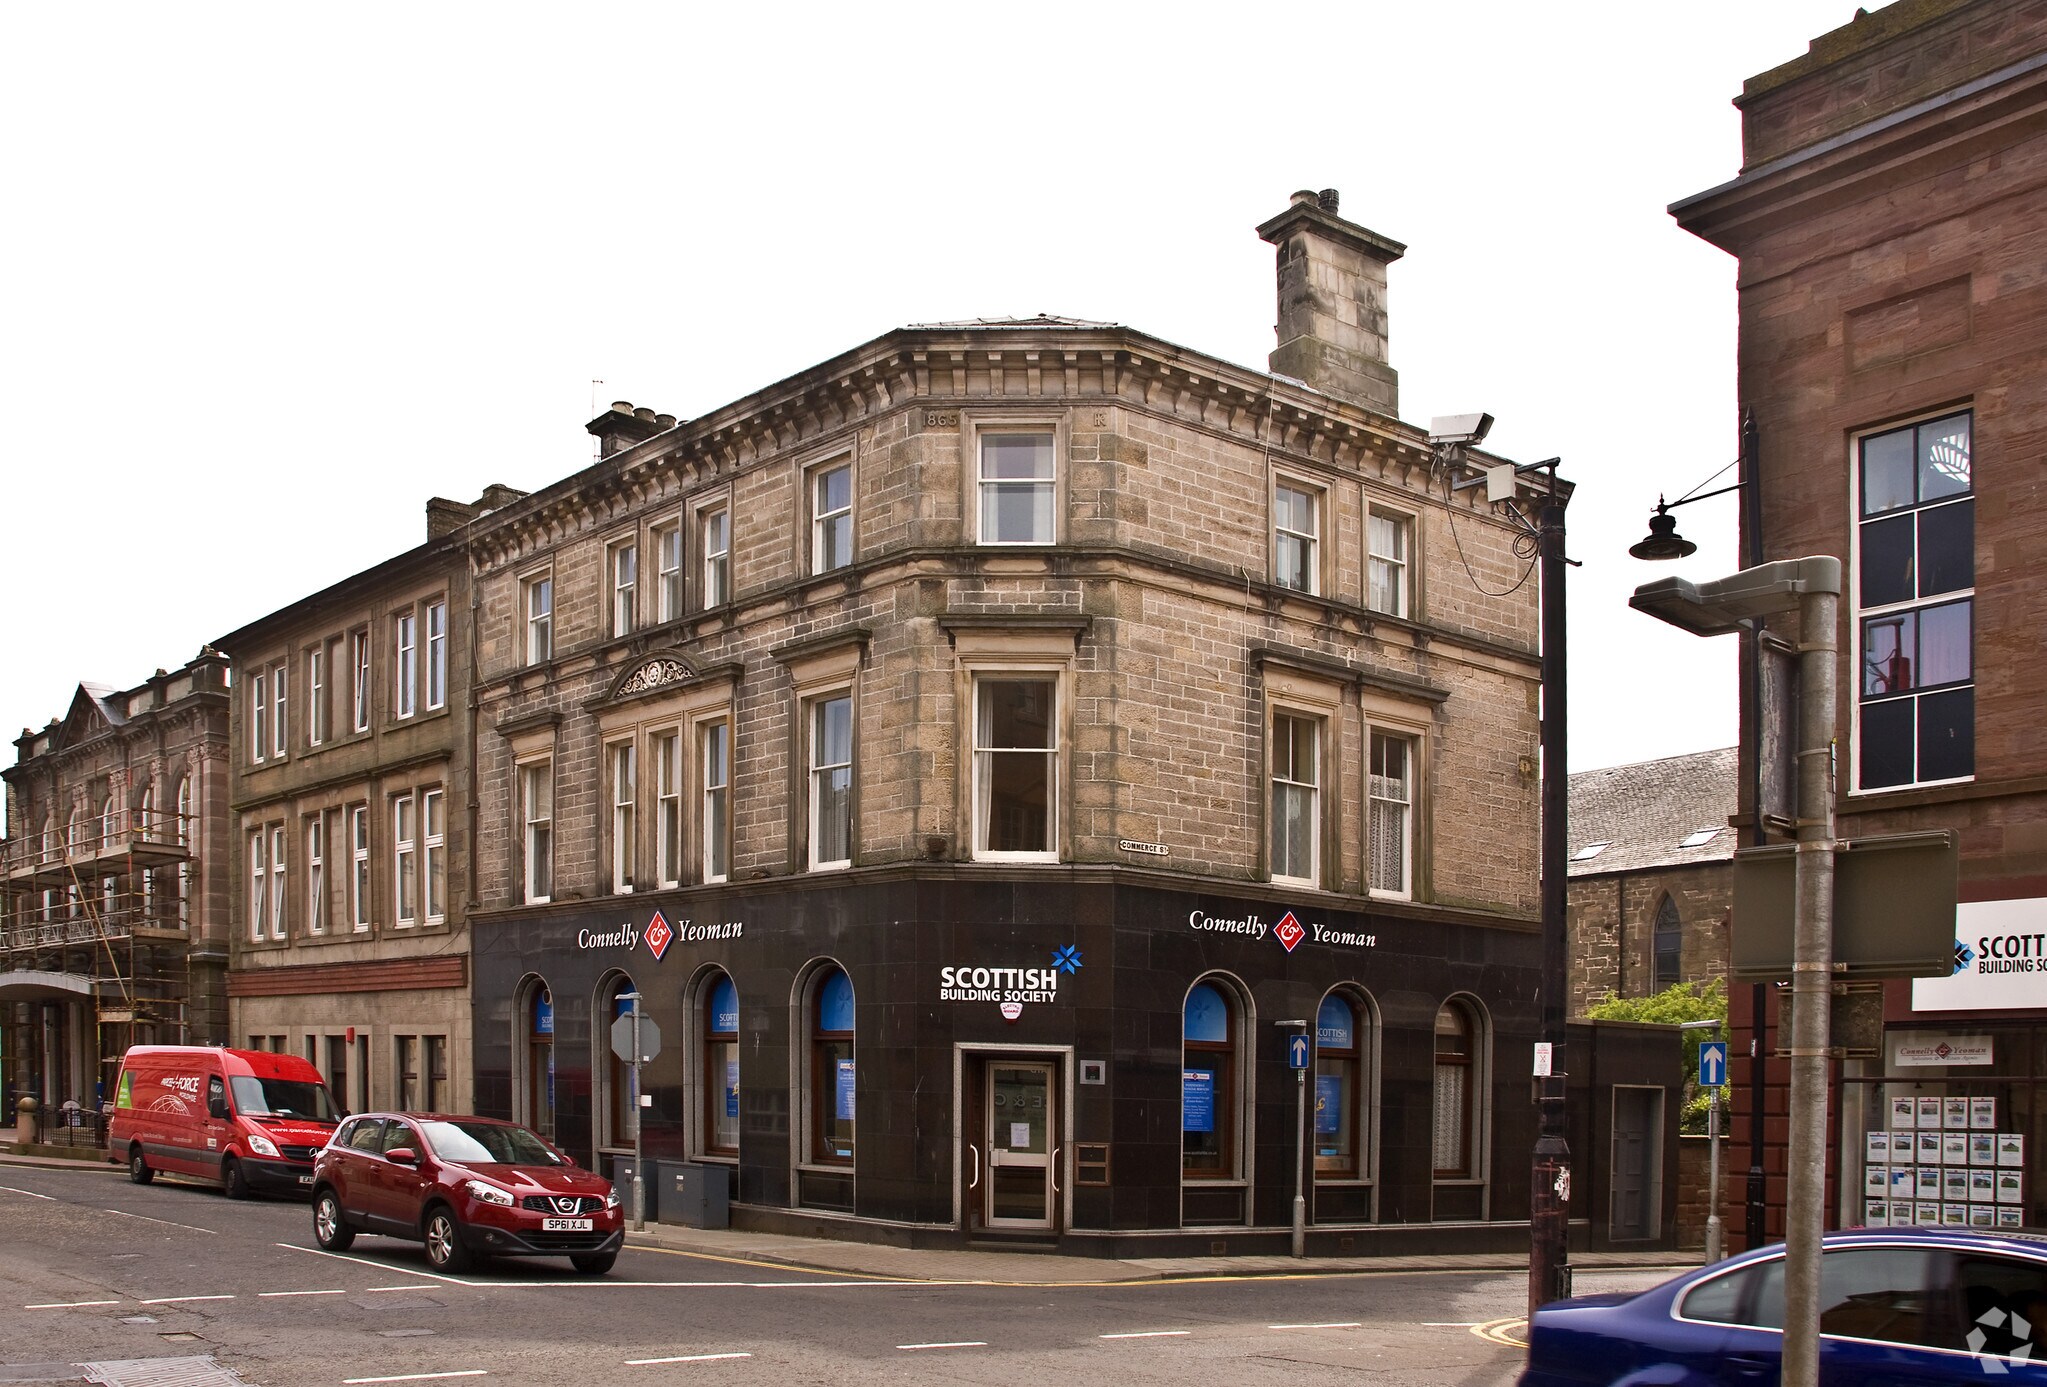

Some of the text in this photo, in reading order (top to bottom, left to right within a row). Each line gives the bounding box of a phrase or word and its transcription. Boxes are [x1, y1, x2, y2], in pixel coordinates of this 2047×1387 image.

[923, 413, 957, 426] 1865
[1122, 841, 1157, 851] COMMERCE
[578, 920, 743, 950] Connelly & Yeoman
[1189, 910, 1376, 947] Connelly & Yeoman
[1978, 934, 2046, 959] SCOTT
[1978, 959, 2033, 974] BUILDING
[941, 966, 1057, 989] SCOTTISH
[940, 988, 1057, 1002] BUILDING SOCIETY
[1317, 1028, 1347, 1038] COTTISH
[1900, 1047, 1935, 1056] Connelly
[1954, 1046, 1987, 1054] Yeoman
[548, 1220, 587, 1229] SP61 XJL
